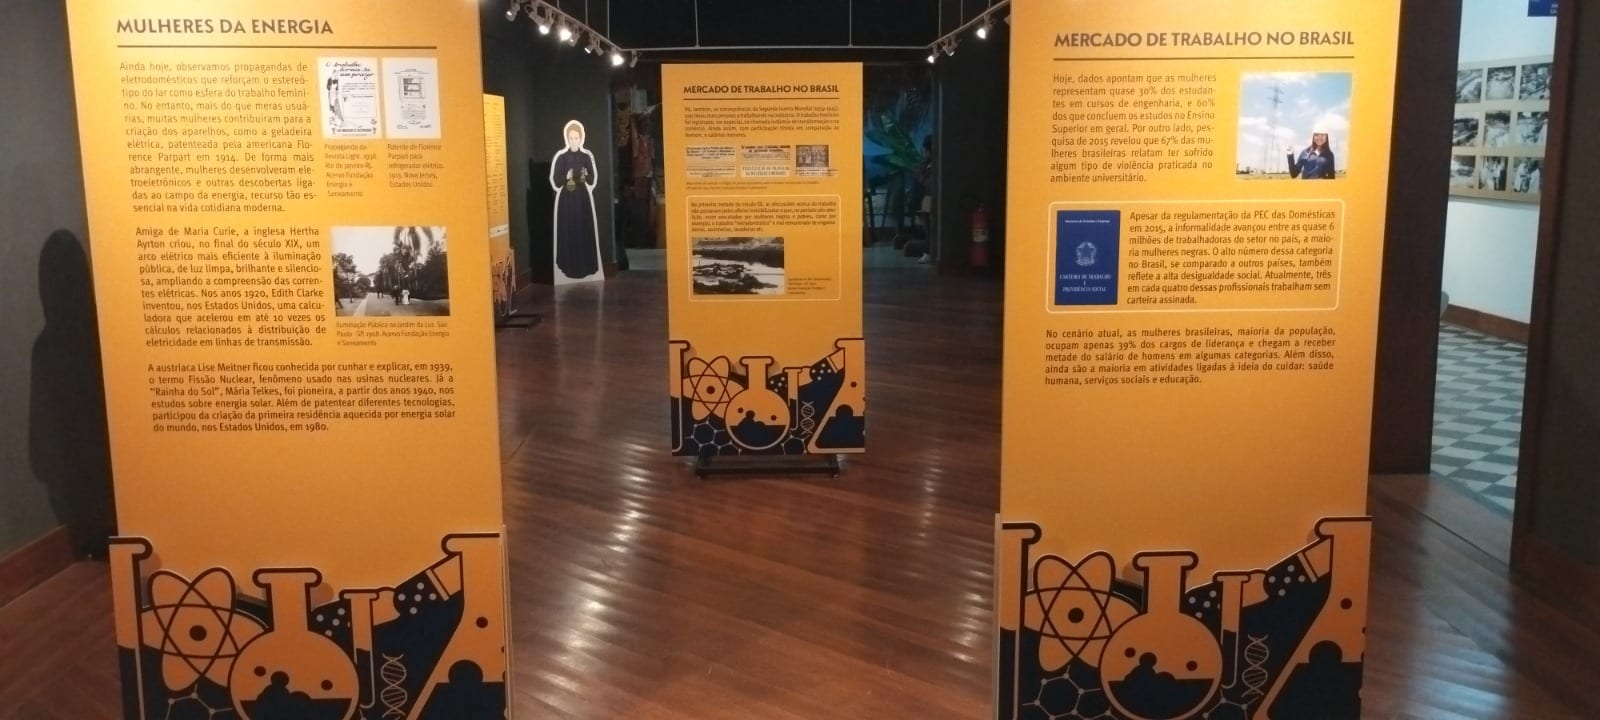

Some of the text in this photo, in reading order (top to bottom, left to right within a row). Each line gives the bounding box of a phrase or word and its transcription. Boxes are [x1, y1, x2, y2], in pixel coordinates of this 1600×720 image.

[117, 19, 333, 34] MULHERES DA ENERGIA
[1054, 31, 1355, 47] MERCADO DE TRABALHO NO BRASIL
[1053, 74, 1075, 84] Hoje,
[1077, 74, 1104, 82] dados
[1106, 74, 1144, 84] apontam
[1146, 76, 1163, 84] que
[1177, 73, 1217, 82] mulheres
[1053, 87, 1106, 97] representam
[1109, 88, 1136, 97] quase
[1139, 86, 1158, 96] 30%
[1160, 86, 1176, 94] dos
[127, 140, 164, 148] elétrica,
[168, 140, 218, 150] patenteada
[222, 140, 242, 150] pela
[158, 153, 190, 162] Parpart
[216, 155, 238, 163] 1914.
[244, 153, 256, 161] De
[261, 152, 287, 161] forma
[293, 153, 314, 162] mais
[1051, 147, 1077, 158] lheres
[1081, 149, 1127, 158] brasileiras
[1130, 148, 1163, 157] relatam
[1183, 148, 1214, 156] sofrido
[129, 166, 184, 176] abrangente,
[185, 165, 228, 174] mulheres
[229, 166, 298, 174] desenvolveram
[1050, 171, 1147, 182] ambiente universitário.
[130, 178, 192, 187] troeletrônicos
[238, 178, 292, 186] descobertas
[1130, 210, 1336, 222] Apesar da regulamentação da PEC das Domésticas
[160, 252, 194, 260] elétrico
[197, 252, 219, 260] mais
[222, 252, 260, 260] eficiente
[272, 252, 322, 262] iluminação
[1128, 272, 1154, 280] reflete
[1162, 272, 1179, 280] alta
[1180, 271, 1235, 281] desigualdade
[1236, 270, 1263, 279] social.
[1264, 270, 1314, 280] Atualmente,
[1316, 270, 1332, 278] três
[1141, 284, 1161, 292] cada
[1161, 284, 1188, 294] quatro
[1189, 284, 1218, 292] dessas
[1218, 282, 1270, 293] profissionais
[1271, 282, 1312, 290] trabalham
[1126, 295, 1196, 304] carteira assinada.
[144, 326, 181, 334] cálculos
[186, 326, 242, 334] relacionados
[258, 326, 310, 335] distribuição
[315, 325, 327, 334] de
[1046, 330, 1058, 338] No
[1062, 329, 1094, 338] cenário
[1098, 329, 1123, 338] atual,
[1141, 328, 1181, 336] mulheres
[1185, 328, 1233, 337] brasileiras,
[1237, 327, 1270, 335] maioria
[1274, 327, 1285, 335] da
[1289, 326, 1336, 336] população,
[146, 338, 198, 346] eletricidade
[215, 338, 242, 346] linhas
[244, 338, 256, 346] de
[256, 337, 313, 346] transmissão.
[1046, 351, 1077, 361] metade
[1081, 350, 1092, 361] do
[1095, 352, 1124, 360] salário
[1128, 352, 1138, 360] de
[1142, 352, 1175, 360] homens
[1196, 351, 1231, 361] algumas
[1234, 351, 1280, 360] categorias.
[1284, 350, 1305, 358] Além
[1309, 350, 1334, 359] disso,
[1044, 376, 1082, 386] humana,
[1084, 376, 1119, 385] serviços
[1120, 375, 1150, 384] sociais
[1159, 374, 1202, 384] educação.
[151, 398, 455, 410] estudos sobre energia solar. Além de patentear diferentes tecnologias,
[152, 412, 196, 421] participou
[211, 411, 243, 421] criação
[244, 411, 256, 419] da
[258, 410, 295, 421] primeira
[296, 410, 341, 418] residência
[343, 410, 382, 420] aquecida
[384, 412, 399, 420] por
[400, 410, 433, 420] energia
[434, 410, 456, 418] solar
[166, 423, 200, 432] mundo,
[219, 422, 253, 431] Estados
[254, 422, 288, 432] Unidos,
[305, 422, 329, 432] 1980.
